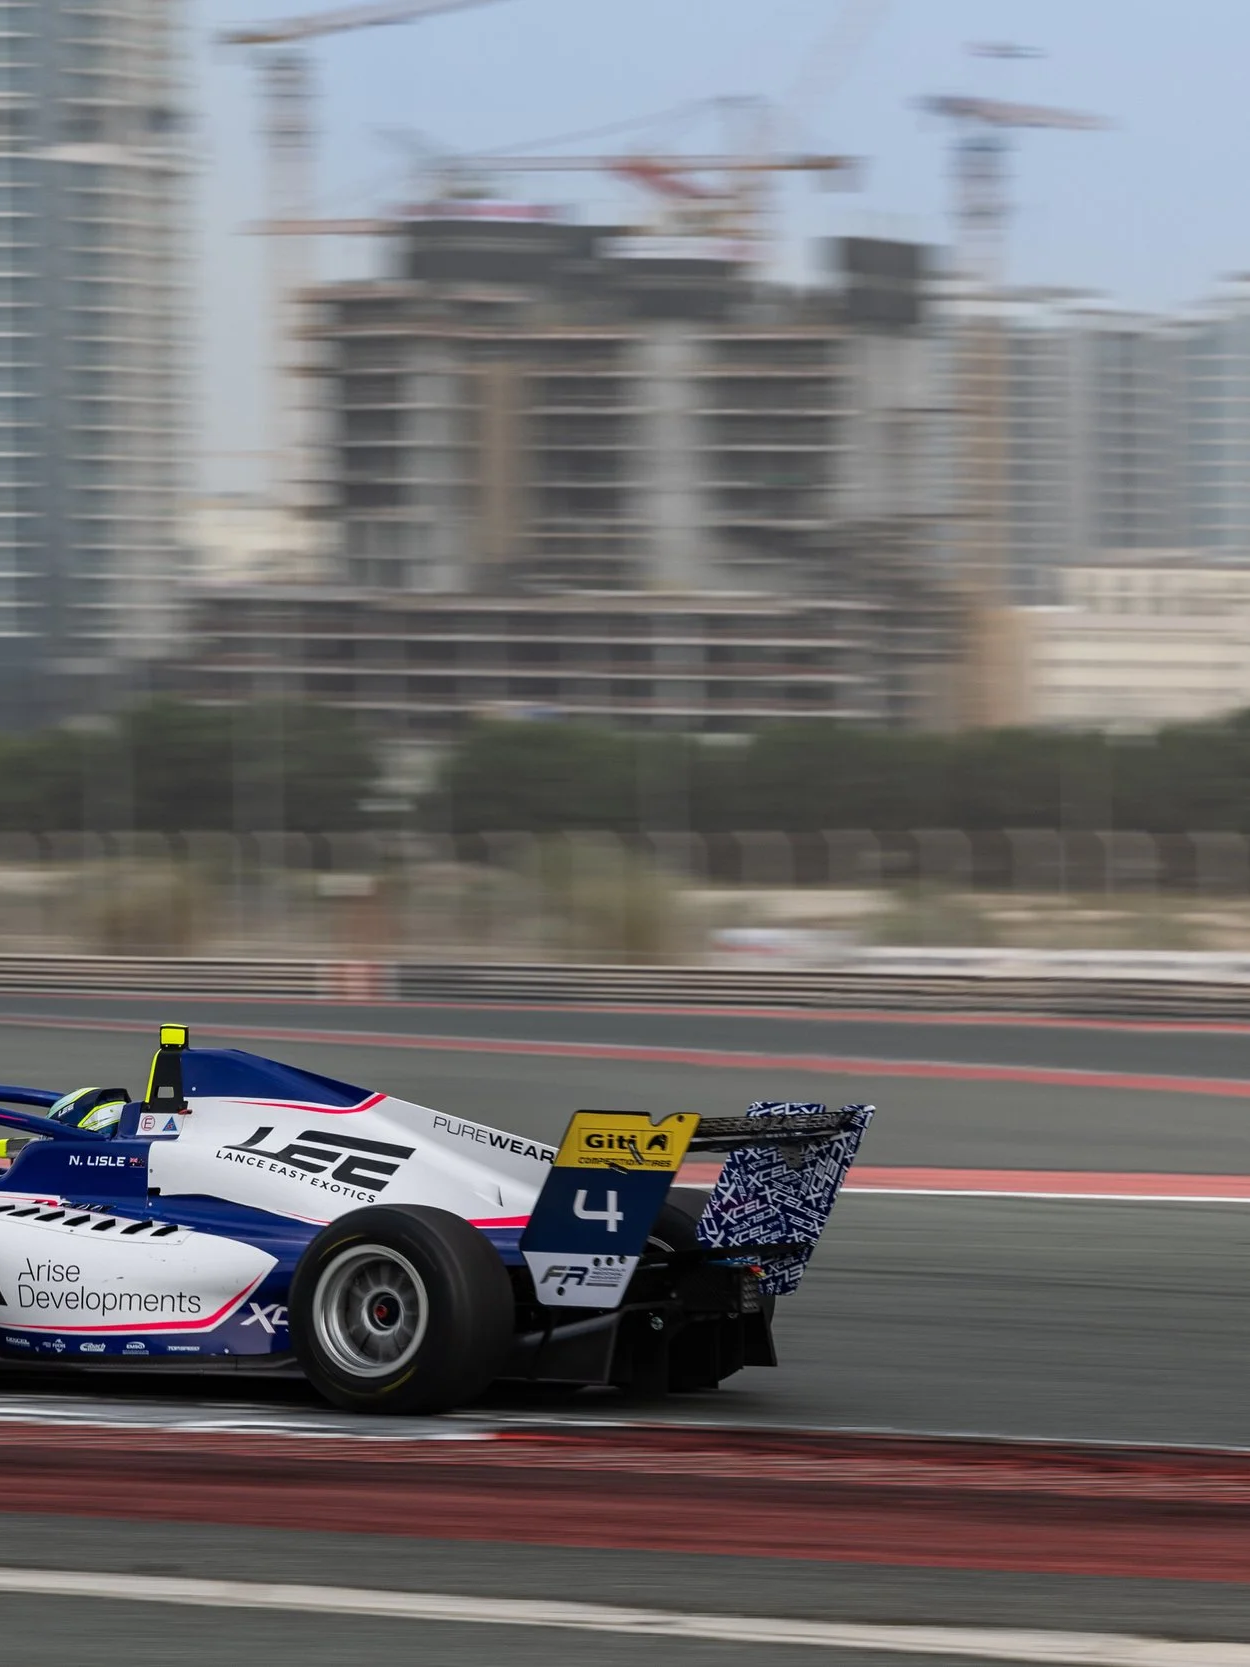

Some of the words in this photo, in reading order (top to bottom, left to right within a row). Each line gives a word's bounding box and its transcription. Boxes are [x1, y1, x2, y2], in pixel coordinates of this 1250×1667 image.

[433, 1116, 555, 1165] PUREWEAR
[585, 1133, 638, 1149] Giti
[68, 1155, 83, 1166] N.
[87, 1156, 126, 1167] LISLE
[222, 1126, 417, 1193] LEE
[215, 1150, 265, 1169] LANCE
[268, 1163, 309, 1181] EAST
[310, 1178, 376, 1203] EXOTICS
[747, 1163, 793, 1188] XCEL
[573, 1189, 624, 1232] 4
[720, 1199, 769, 1226] XCEL
[727, 1225, 770, 1247] XCEL
[17, 1257, 80, 1282] Arise
[540, 1265, 589, 1286] FR
[17, 1284, 201, 1316] Developments
